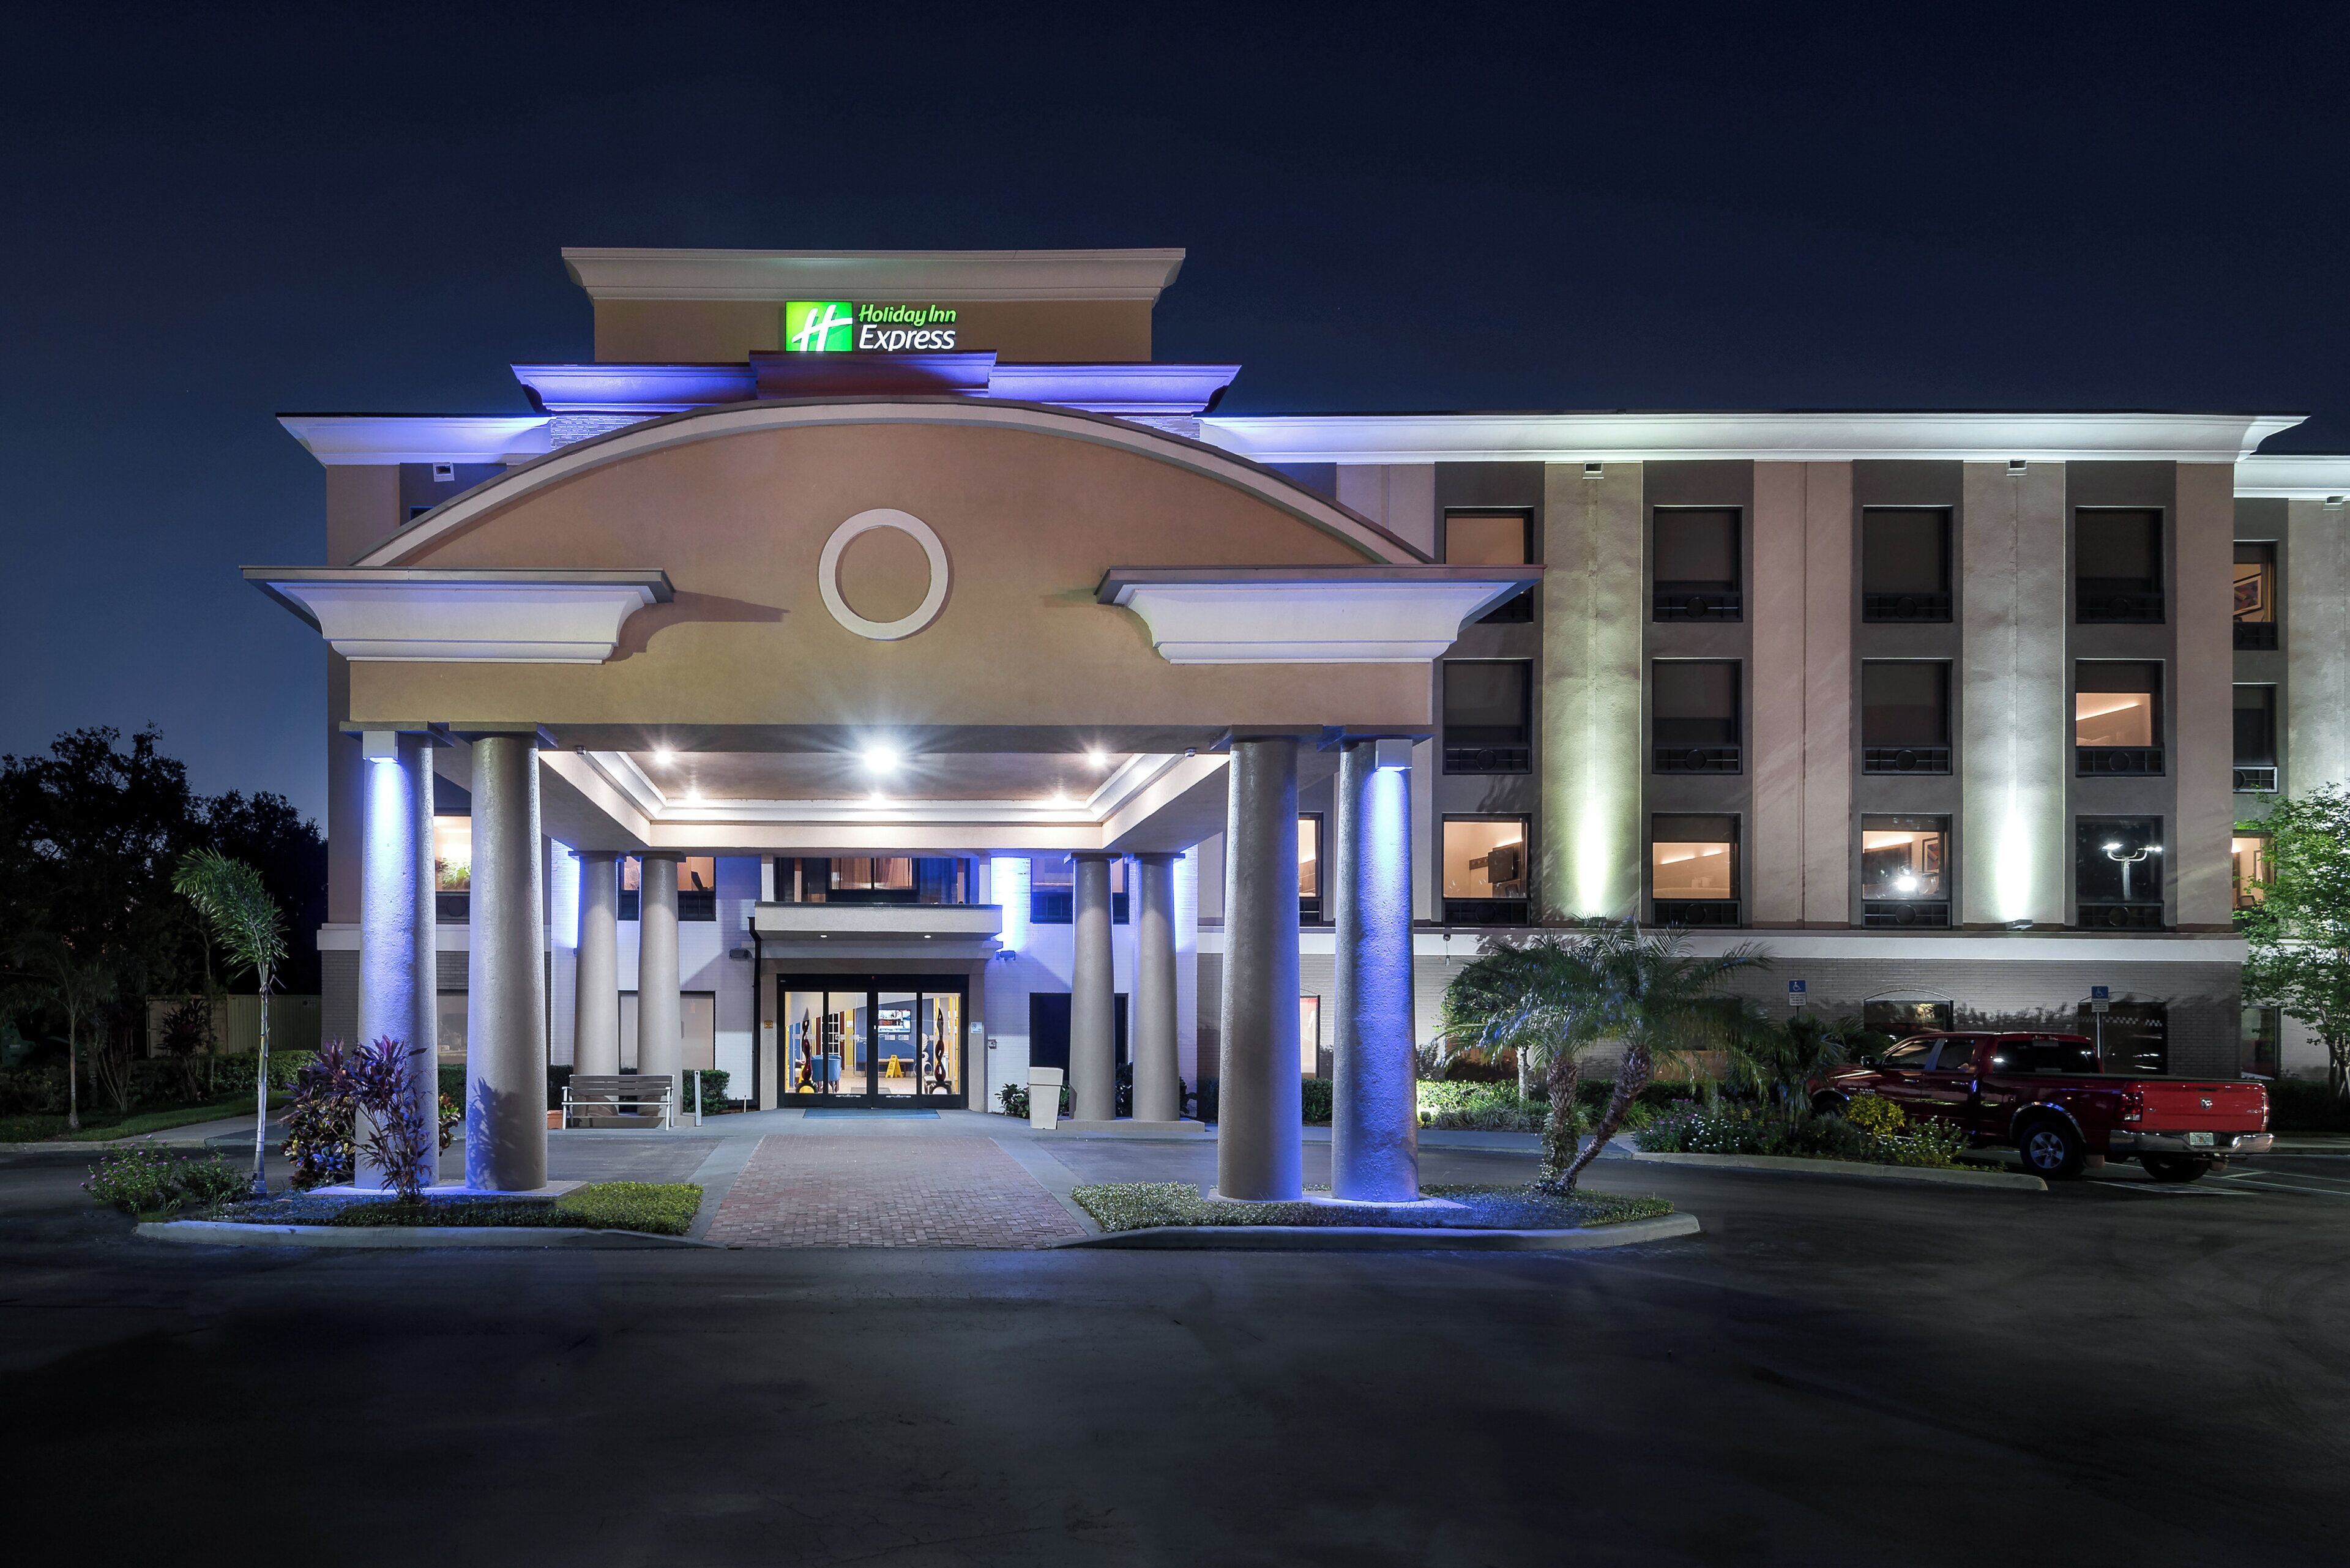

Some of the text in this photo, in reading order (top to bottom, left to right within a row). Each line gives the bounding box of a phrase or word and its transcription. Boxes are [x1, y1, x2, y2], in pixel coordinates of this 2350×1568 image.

[859, 304, 957, 326] Holiday Inn
[859, 324, 956, 351] Express
